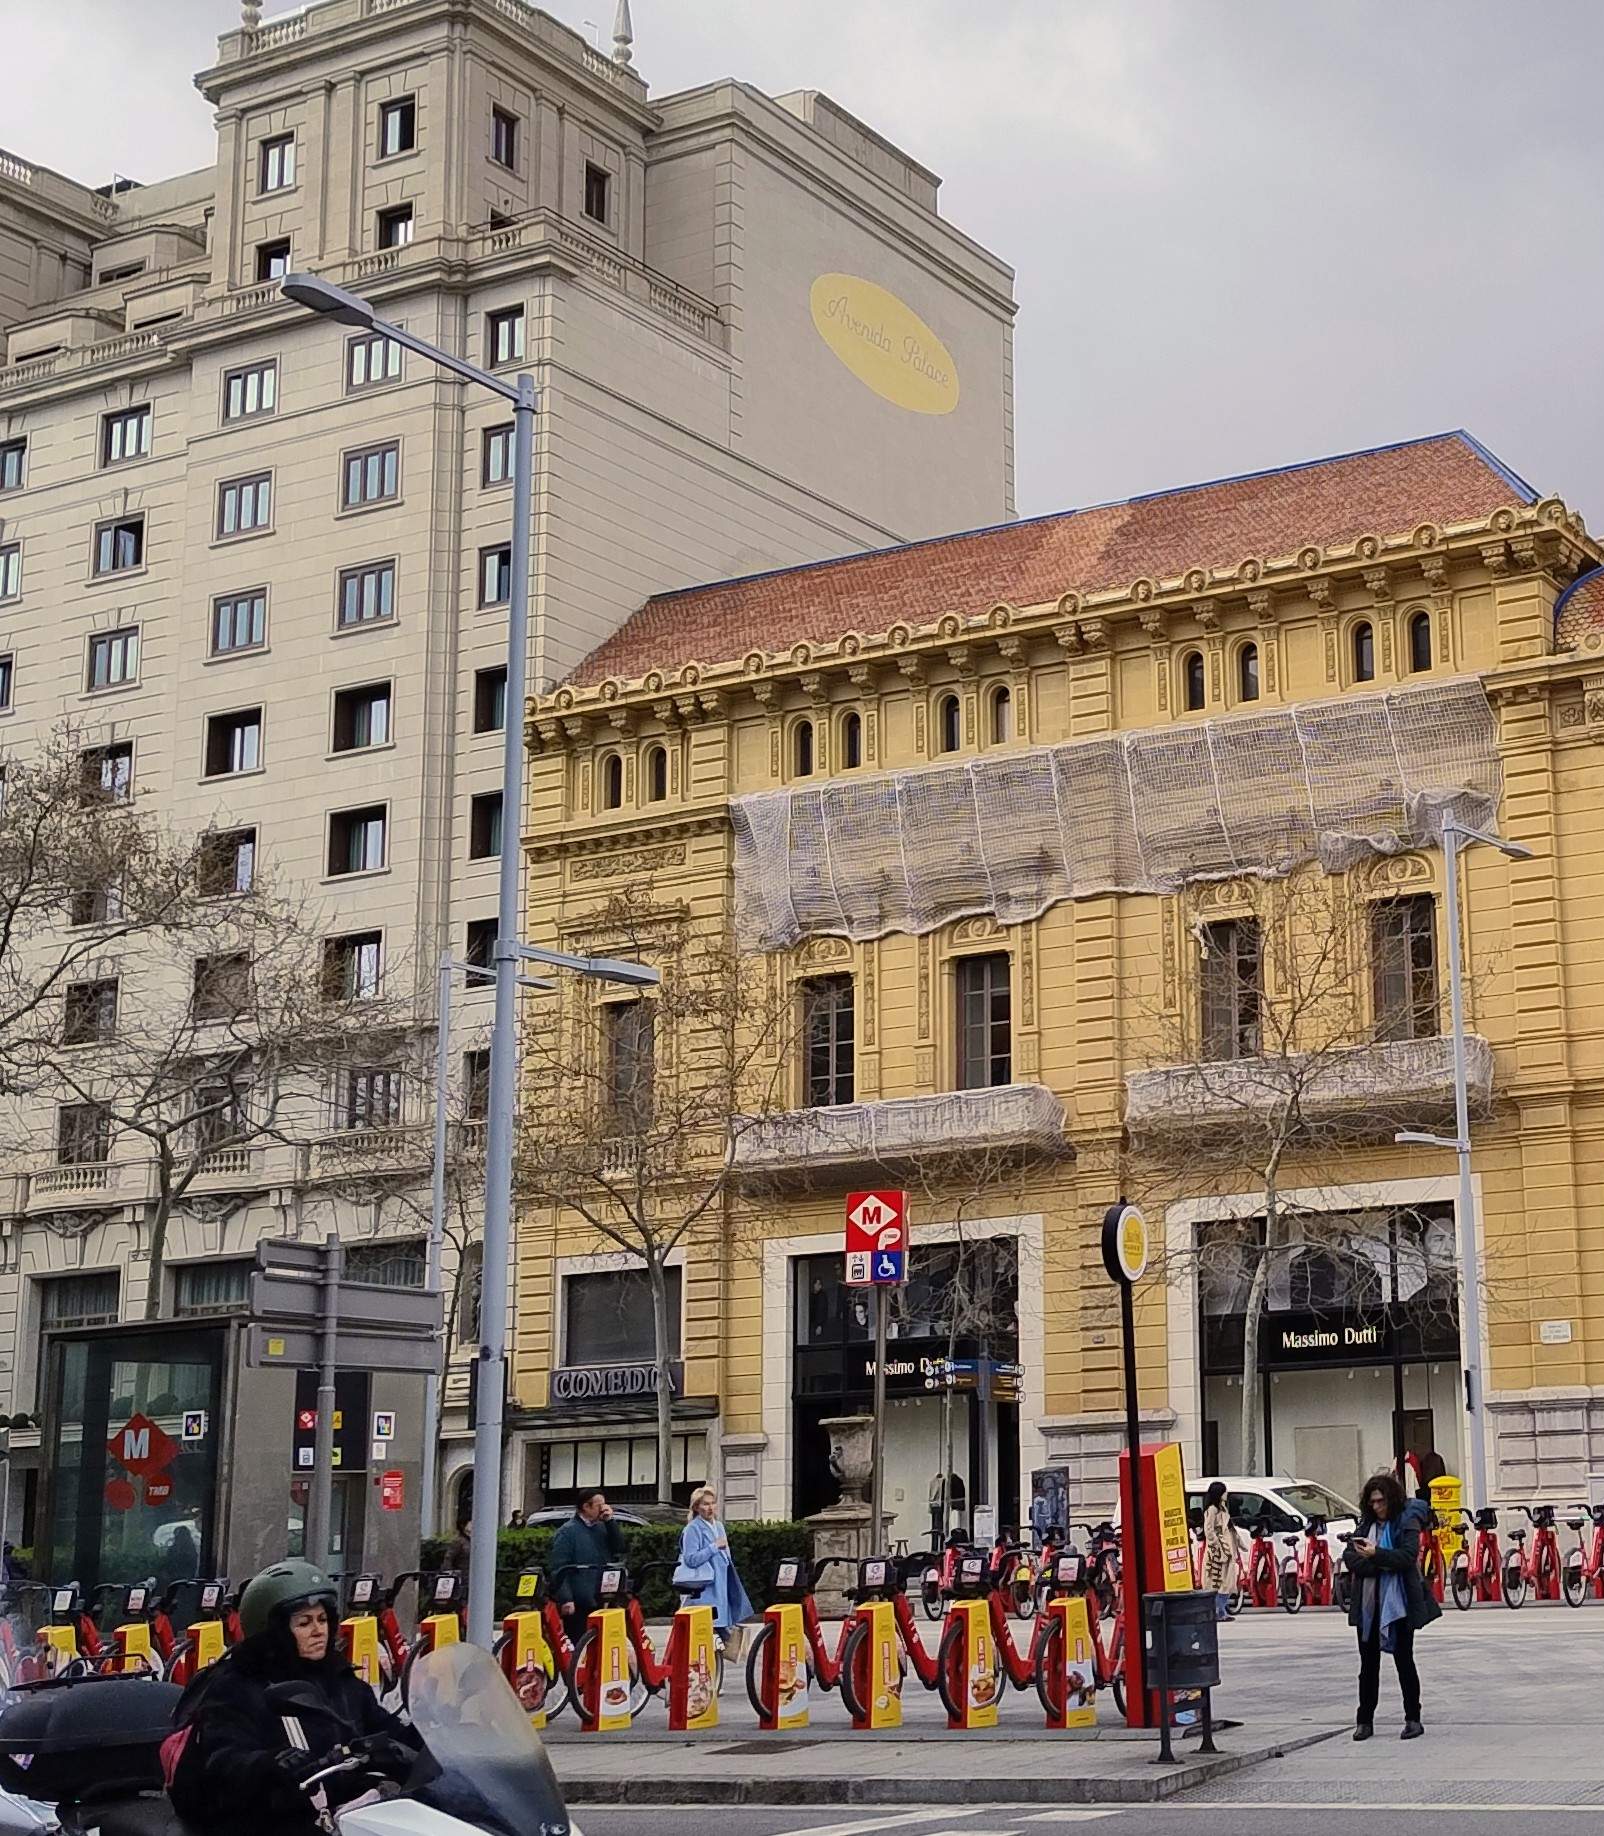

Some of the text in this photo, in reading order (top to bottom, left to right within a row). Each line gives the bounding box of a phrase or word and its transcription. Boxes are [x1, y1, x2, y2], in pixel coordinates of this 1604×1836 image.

[823, 296, 949, 389] Avenida Palace
[862, 1205, 882, 1225] M
[1282, 1326, 1377, 1348] Massimo Dutti
[124, 1428, 150, 1460] M
